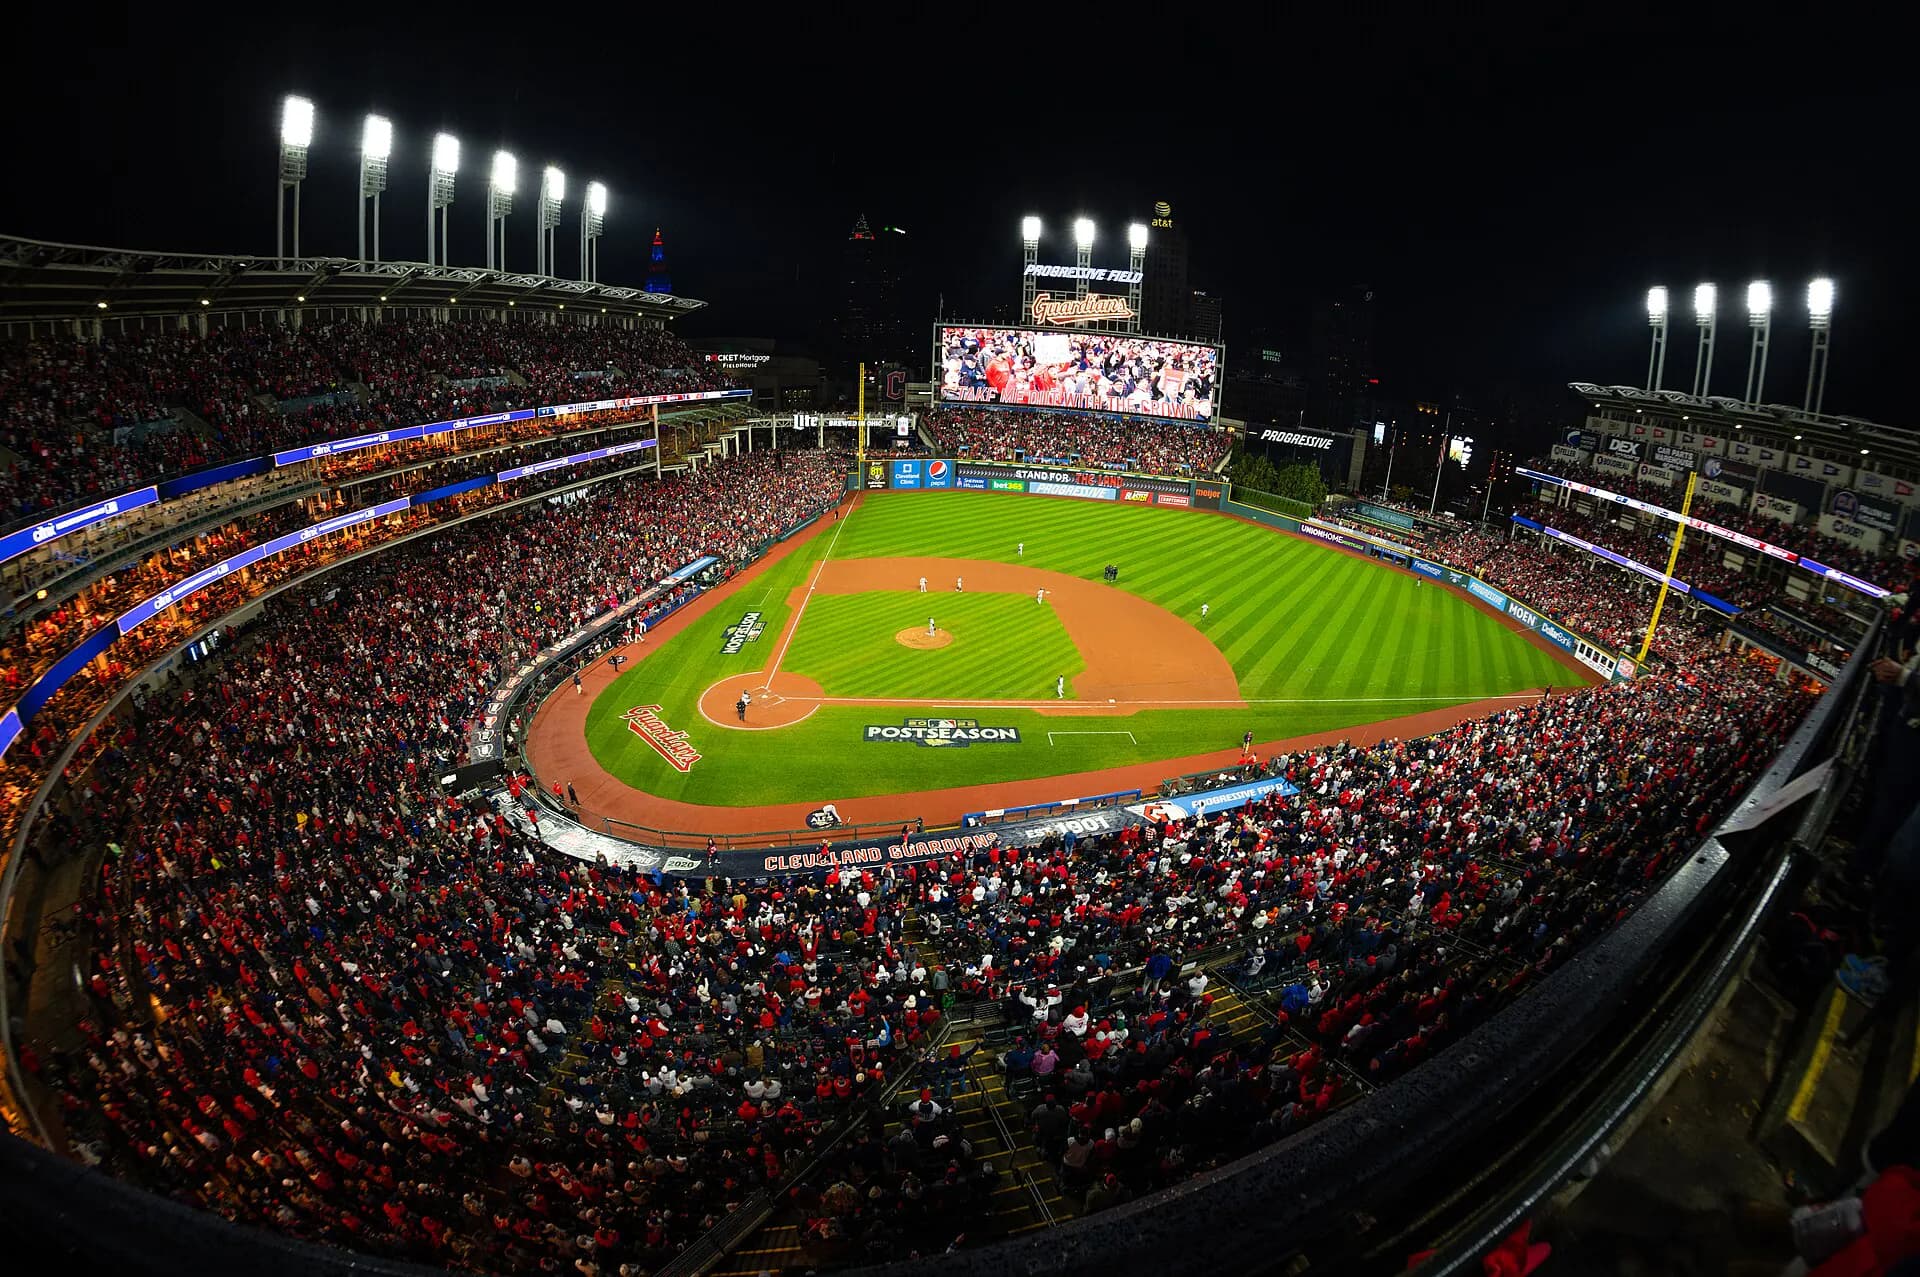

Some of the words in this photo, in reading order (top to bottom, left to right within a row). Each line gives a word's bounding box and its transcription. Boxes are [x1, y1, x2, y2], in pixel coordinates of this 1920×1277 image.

[1152, 218, 1173, 228] at&t
[1024, 264, 1107, 281] PROGRESSIVE
[1107, 270, 1144, 284] FIELD
[1032, 293, 1134, 324] Guardians
[705, 354, 738, 362] ROCKET
[740, 354, 770, 362] Mortgage
[959, 386, 998, 402] TAKE
[1261, 430, 1333, 449] PROGRESSIVE
[1609, 439, 1640, 454] DEX
[1655, 454, 1695, 468] WAREHOUSE
[1657, 446, 1671, 455] CAR
[1672, 450, 1694, 460] PARTS
[994, 480, 1022, 490] bet365
[1015, 470, 1048, 480] STAND
[1050, 472, 1068, 482] FOR
[1076, 473, 1096, 485] THE
[1098, 474, 1122, 488] LAND
[1037, 482, 1107, 498] PROGRESSIVE
[1196, 488, 1220, 499] meijer
[1414, 561, 1442, 576] FirstEnergy
[1470, 582, 1504, 606] PROGRESSIVE
[1508, 603, 1536, 626] MOEN
[723, 613, 760, 653] POSTSEASON
[619, 704, 702, 772] Guardians
[868, 727, 1016, 739] POSTSEASON
[1192, 788, 1256, 808] POGRESSIVE
[1055, 816, 1110, 835] 1901
[668, 860, 694, 868] 2020
